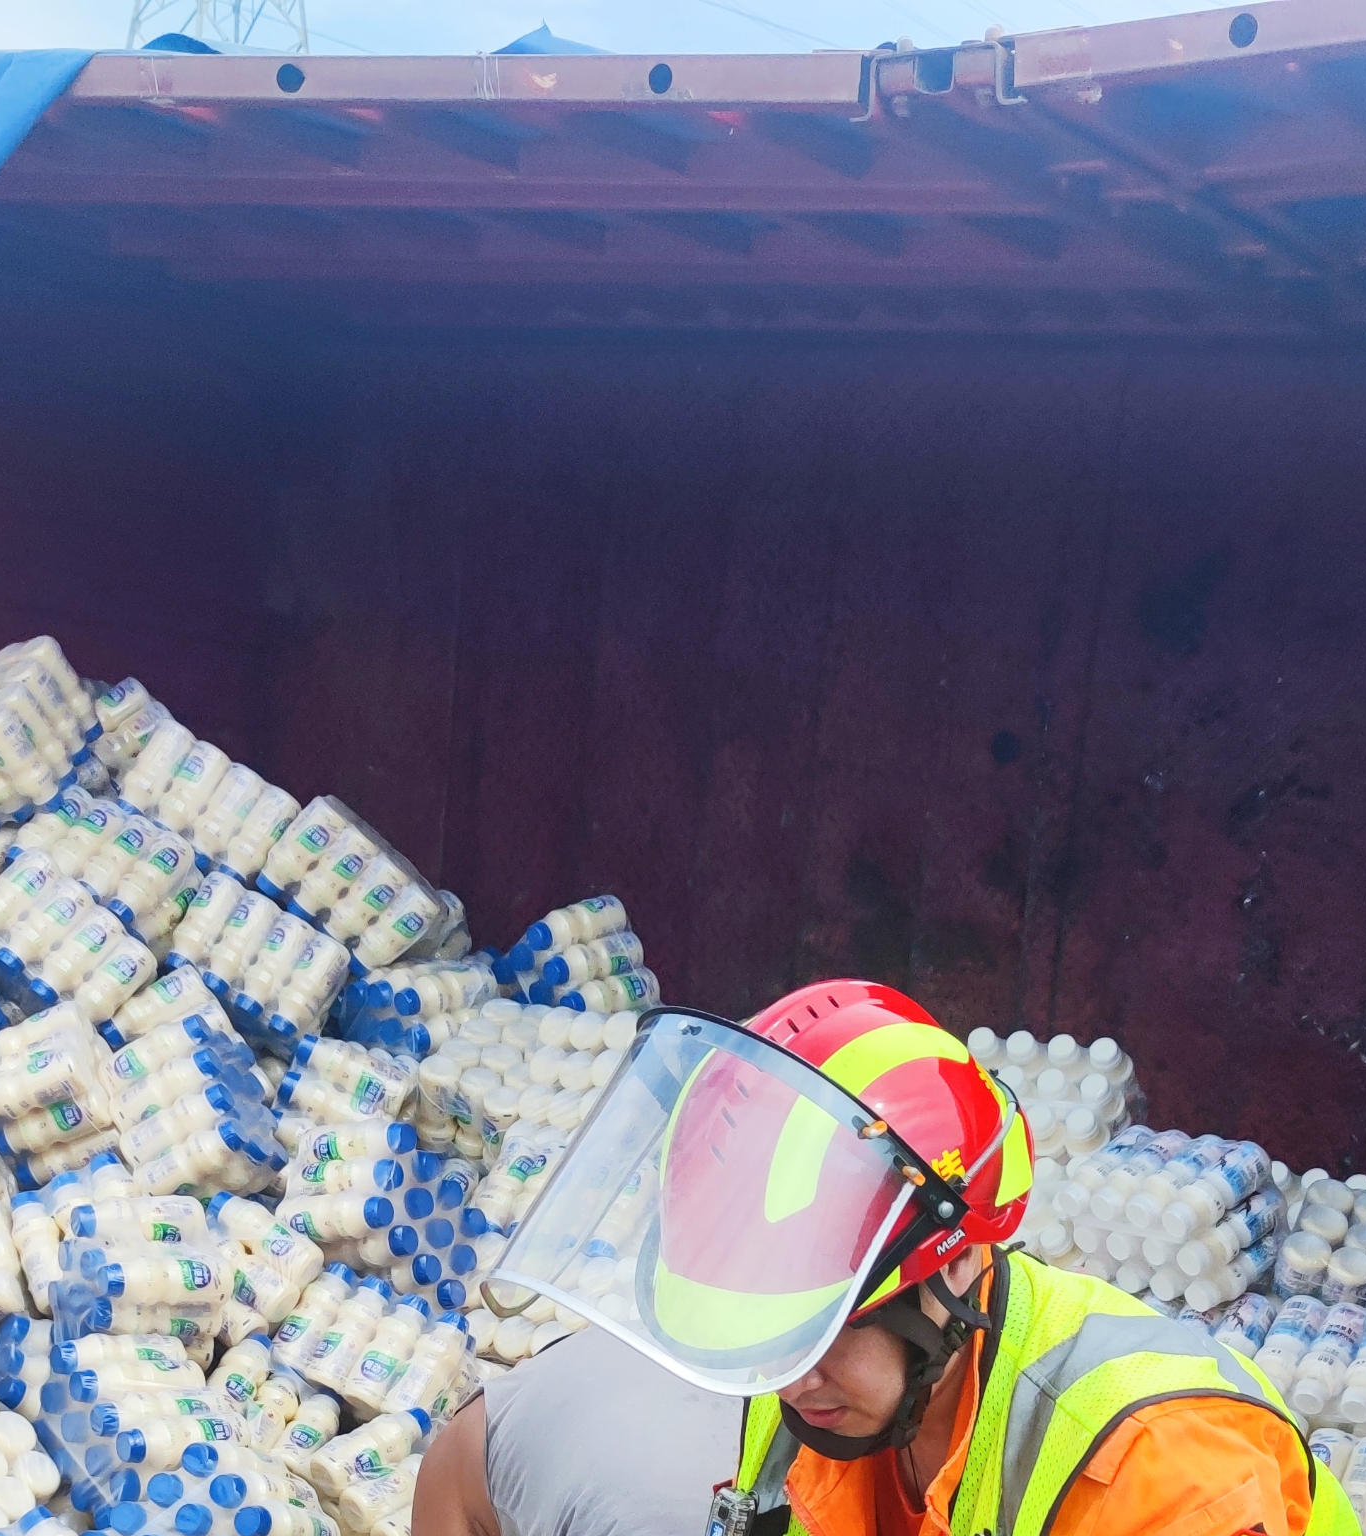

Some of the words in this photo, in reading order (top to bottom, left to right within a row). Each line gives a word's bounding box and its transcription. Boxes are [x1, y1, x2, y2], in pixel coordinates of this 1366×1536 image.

[937, 1229, 966, 1256] MSA
[363, 1359, 391, 1378] 胃动力
